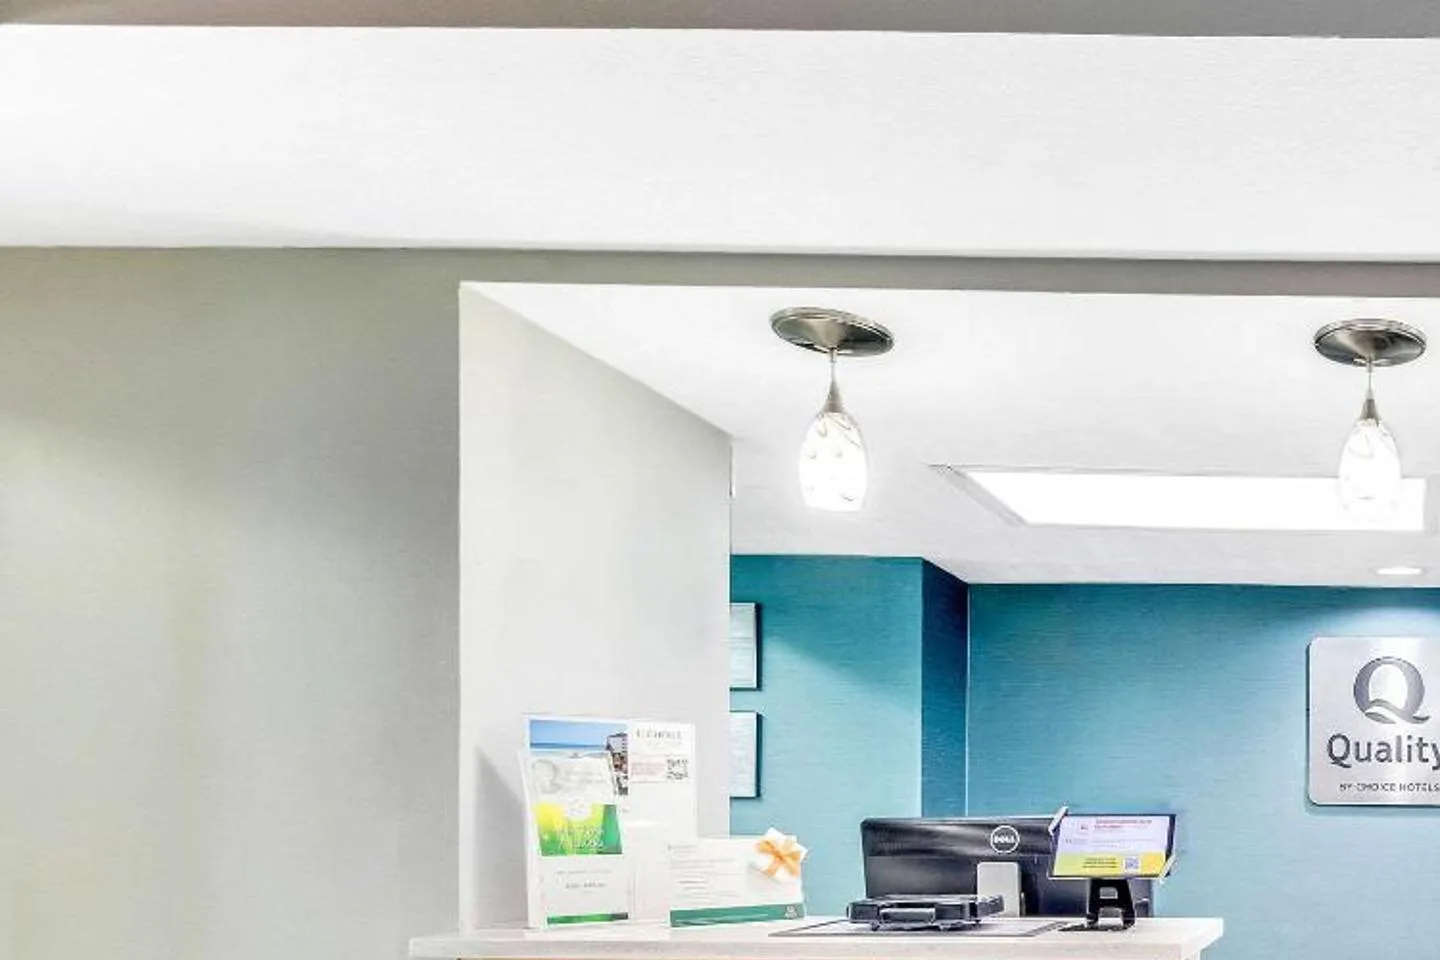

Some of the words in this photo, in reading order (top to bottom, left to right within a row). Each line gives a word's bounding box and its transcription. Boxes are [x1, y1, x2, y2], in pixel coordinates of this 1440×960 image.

[1339, 782, 1353, 792] BY
[1355, 782, 1396, 792] CHOICE
[1399, 782, 1440, 792] HOTELS
